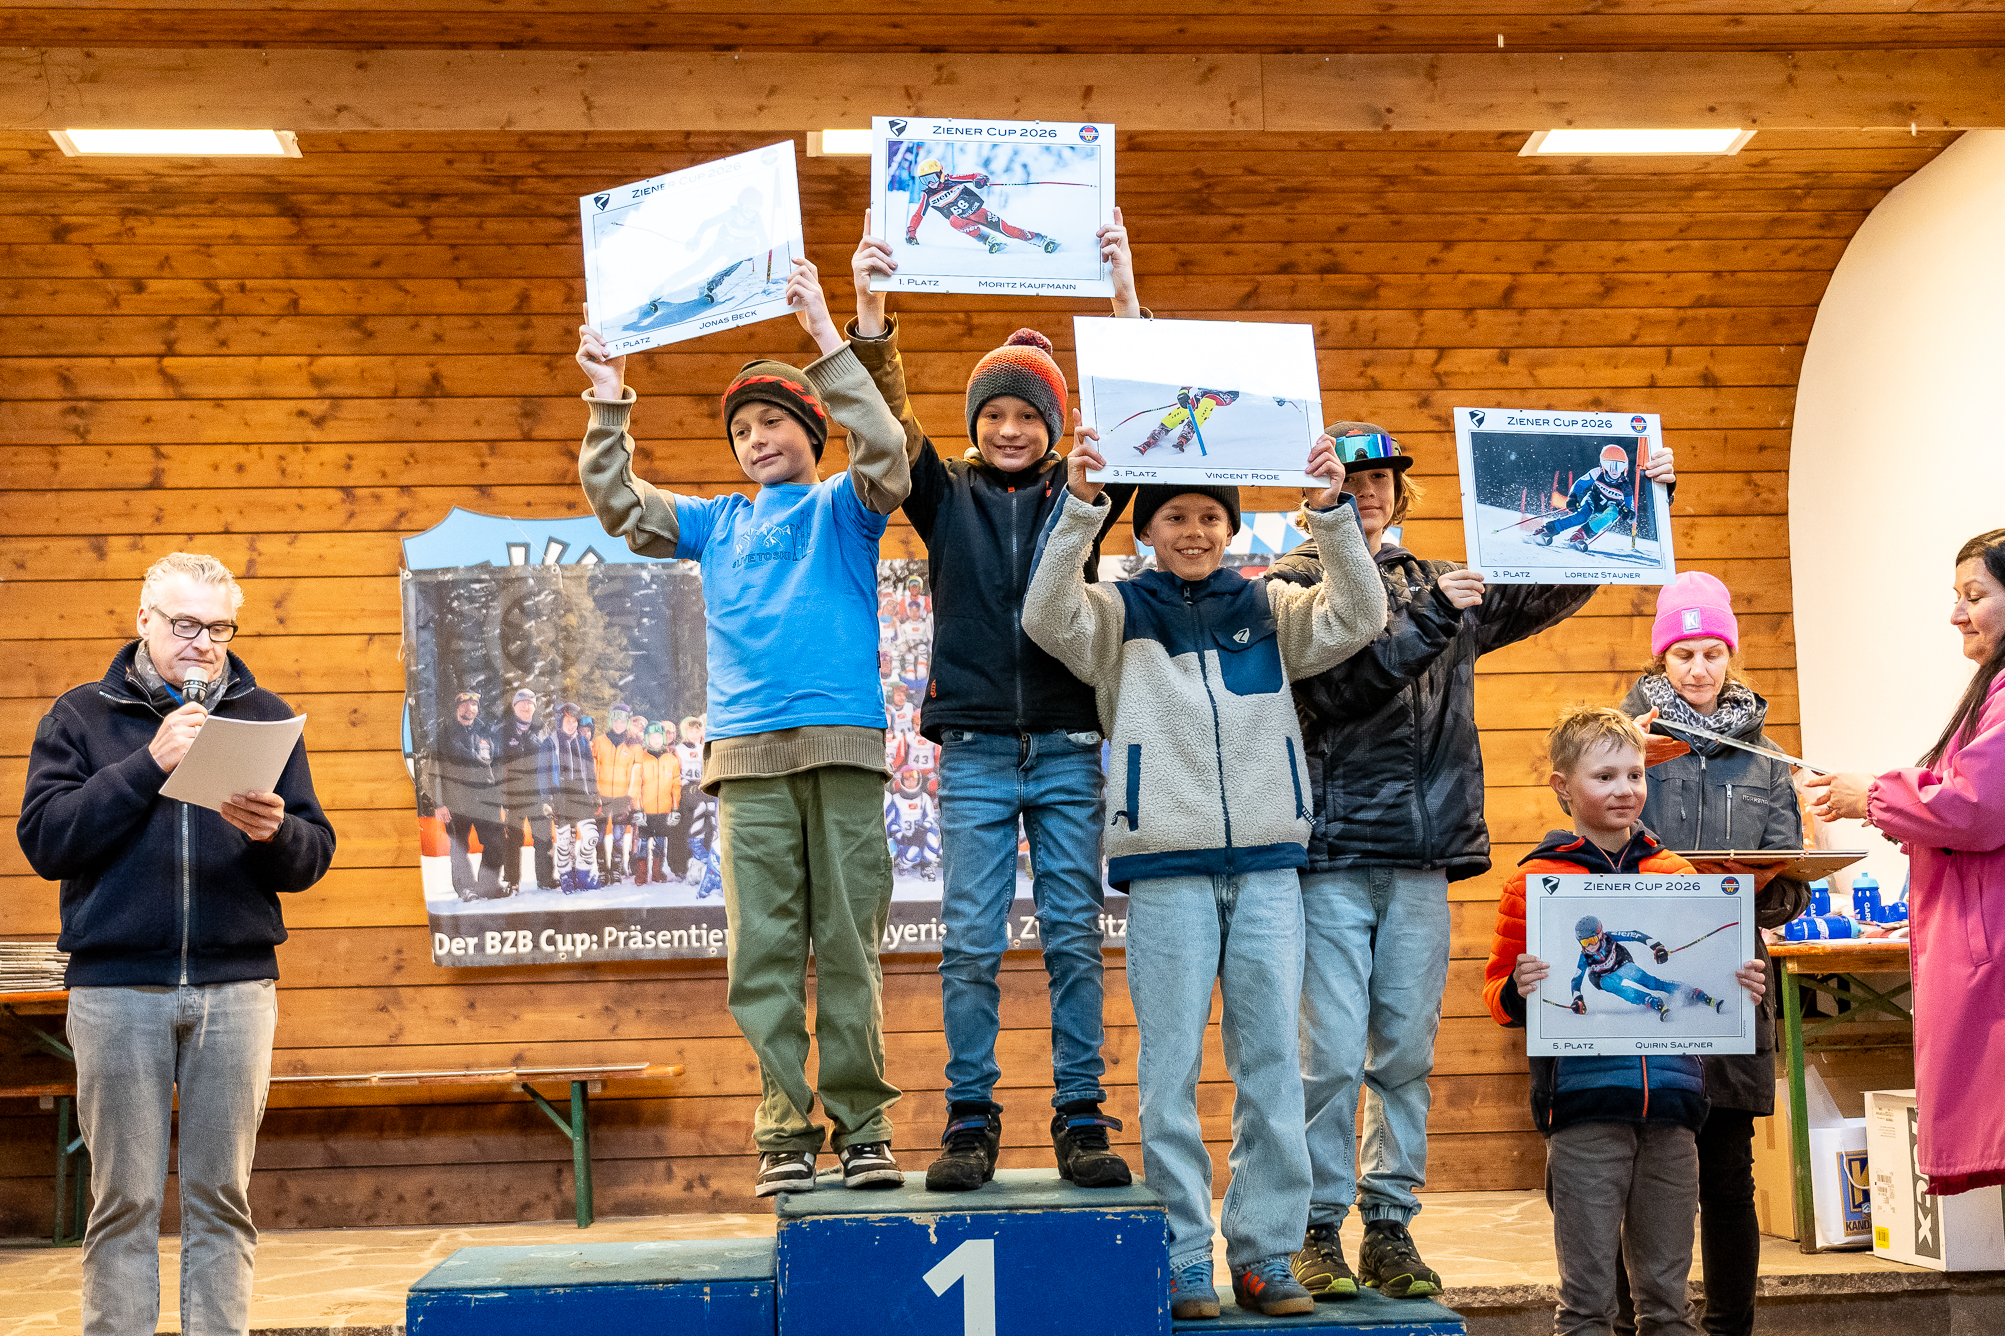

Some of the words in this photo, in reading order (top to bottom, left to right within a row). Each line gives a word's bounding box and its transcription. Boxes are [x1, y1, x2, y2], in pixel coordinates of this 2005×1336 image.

[932, 125, 983, 136] ZIENER
[986, 127, 1017, 137] CUP
[1019, 128, 1058, 138] 2026
[708, 162, 742, 178] 2026
[898, 278, 905, 286] 1.
[907, 278, 940, 287] PLATZ
[978, 280, 1017, 289] MORITZ
[1019, 281, 1077, 290] KAUFMANN
[699, 317, 730, 330] JONAS
[731, 309, 758, 321] BECK
[622, 336, 651, 349] PLATZ
[1506, 416, 1551, 427] ZIENER
[1552, 417, 1579, 428] CUP
[1580, 418, 1613, 429] 2026
[1112, 469, 1124, 477] 3.
[1125, 470, 1158, 478] PLATZ
[1204, 472, 1249, 480] VINCENT
[1251, 473, 1281, 481] RODE
[1492, 570, 1501, 578] 3.
[1564, 571, 1600, 579] LORENZ
[1601, 571, 1641, 579] STAUNER
[912, 754, 929, 765] 43
[1583, 881, 1631, 891] ZIENER
[1634, 881, 1663, 891] CUP
[1667, 881, 1701, 891] 2026
[434, 932, 479, 956] Der
[485, 930, 533, 955] BZB
[540, 929, 598, 958] Cup:
[1552, 1042, 1562, 1050] 5.
[1564, 1042, 1595, 1050] PLATZ
[1634, 1041, 1668, 1050] QUIRIN
[1669, 1041, 1713, 1049] SALFNER
[1845, 1220, 1871, 1232] KAND
[922, 1238, 996, 1336] 1
